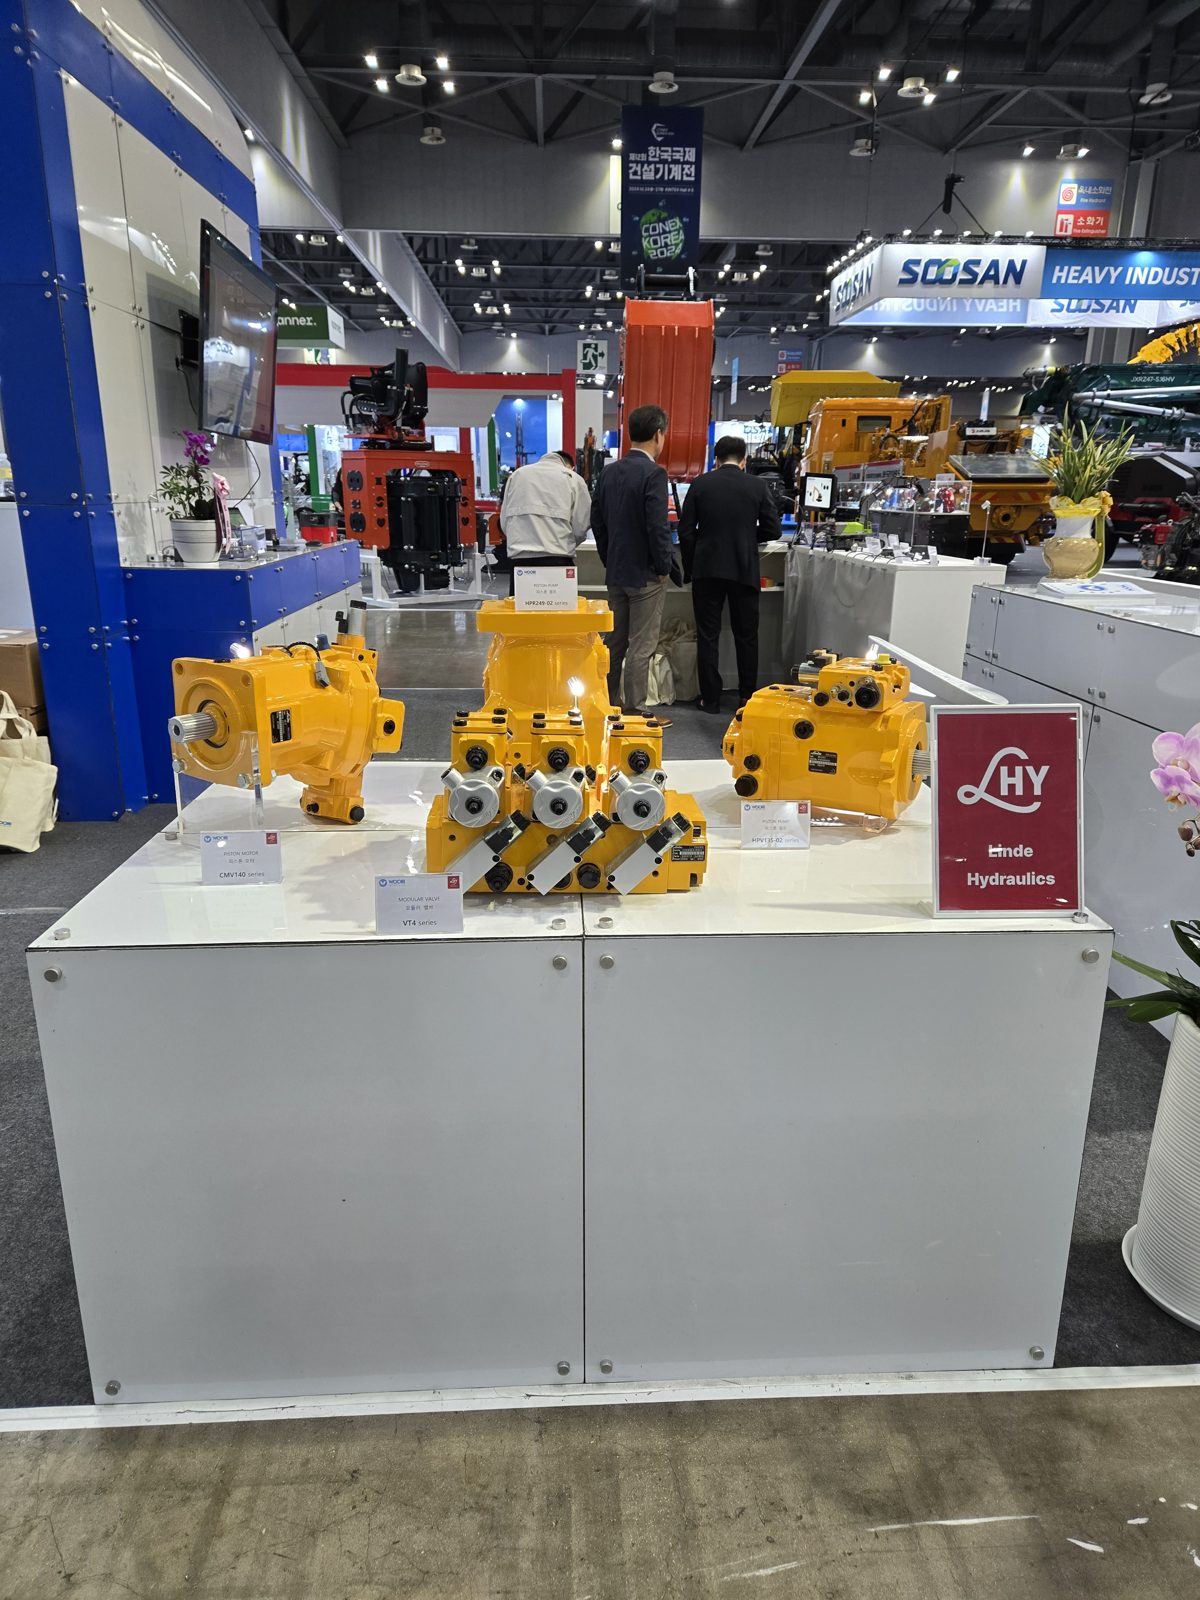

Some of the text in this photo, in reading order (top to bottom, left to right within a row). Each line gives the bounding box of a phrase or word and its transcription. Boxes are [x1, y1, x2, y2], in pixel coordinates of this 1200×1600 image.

[648, 146, 696, 162] 한국국제
[628, 163, 696, 180] 건설기계전
[642, 216, 683, 236] CONEX
[1077, 216, 1104, 225] 소화기
[642, 229, 685, 249] KOREA
[898, 258, 1028, 286] SOOSAN
[1052, 266, 1123, 284] HEAVY
[835, 263, 874, 312] SOOSAN
[988, 844, 1033, 858] Linde
[967, 872, 1055, 889] Hydraulics
